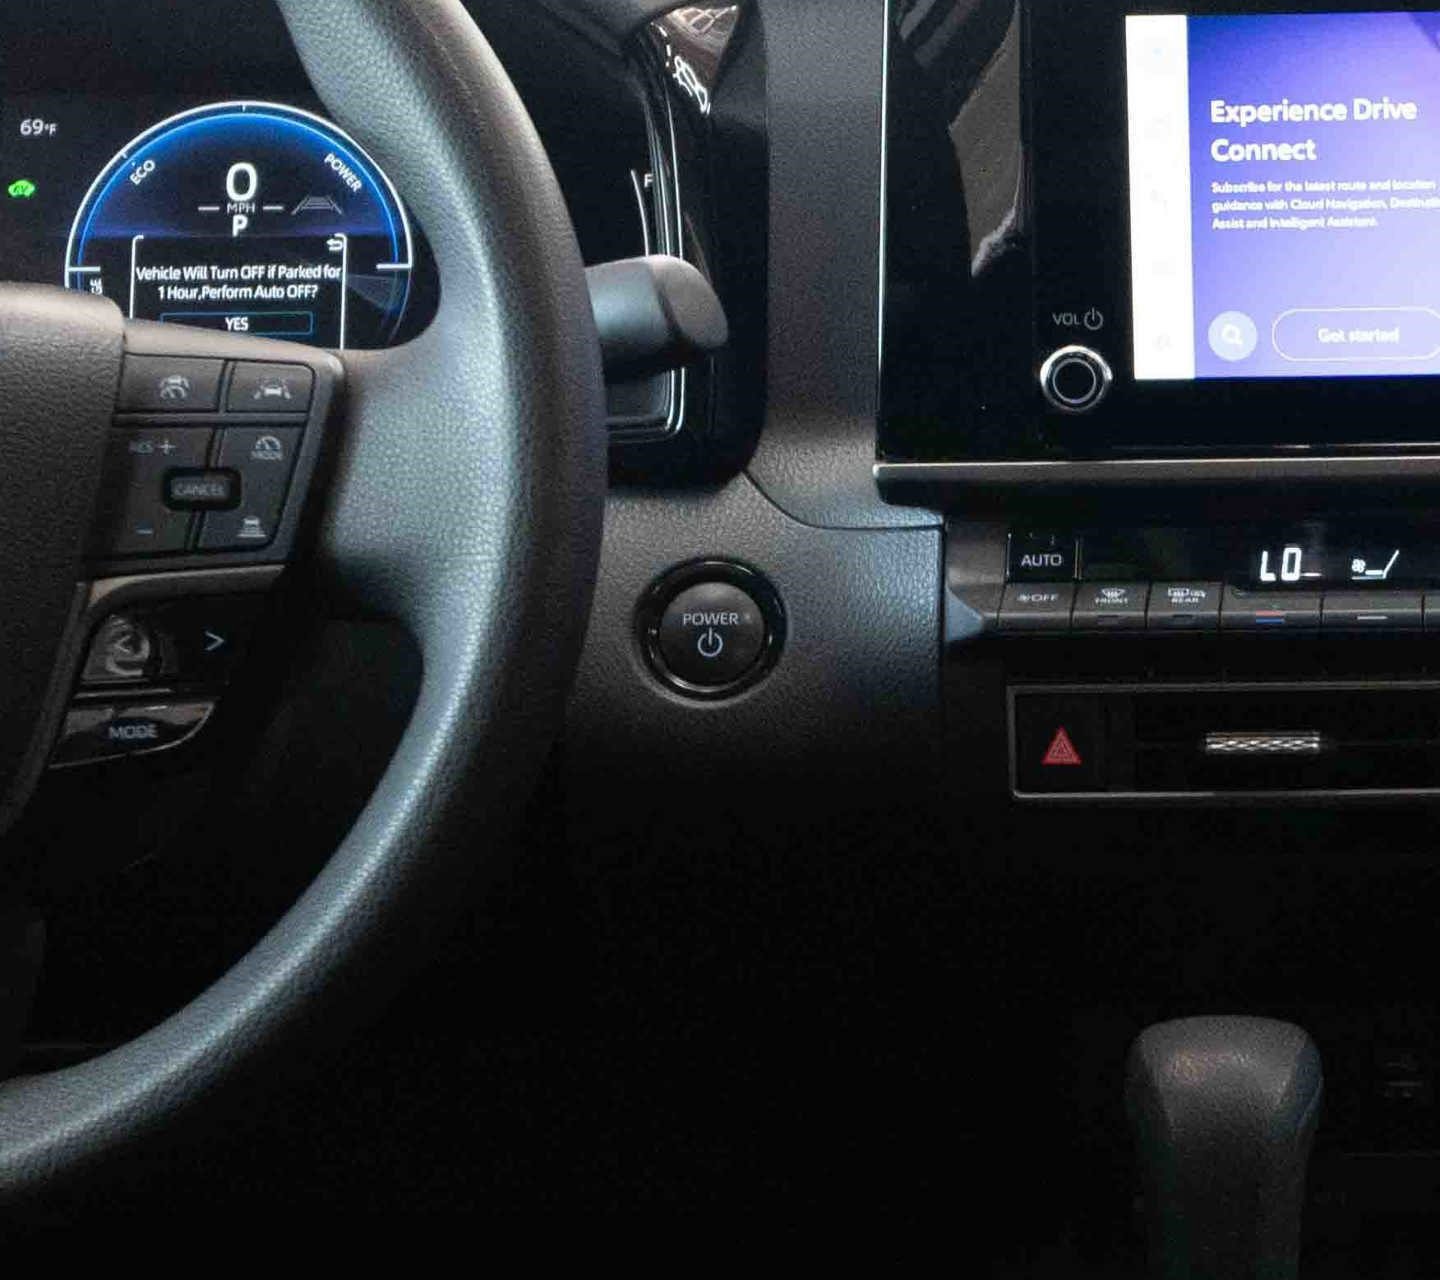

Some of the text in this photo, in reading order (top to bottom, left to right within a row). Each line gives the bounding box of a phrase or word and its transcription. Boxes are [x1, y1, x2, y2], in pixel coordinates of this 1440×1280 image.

[1210, 96, 1418, 127] Experience Drive
[1210, 138, 1318, 162] Connect
[128, 158, 157, 186] ECO
[323, 153, 363, 193] POWER
[225, 162, 258, 202] 0
[227, 202, 255, 214] MPH
[1290, 198, 1324, 210] Cloud
[232, 215, 248, 237] P
[136, 263, 341, 281] Vehicle Will Turn OFF if Parked for
[158, 285, 165, 300] 1
[254, 284, 285, 299] Auto
[287, 283, 318, 298] OFF?
[225, 317, 249, 331] YES
[1052, 312, 1080, 325] VOL
[1318, 328, 1346, 343] Get
[174, 482, 225, 497] CANCEL
[1021, 553, 1062, 567] AUTO
[1031, 593, 1058, 603] OFF
[683, 612, 739, 626] POWER
[110, 724, 158, 739] MODE
